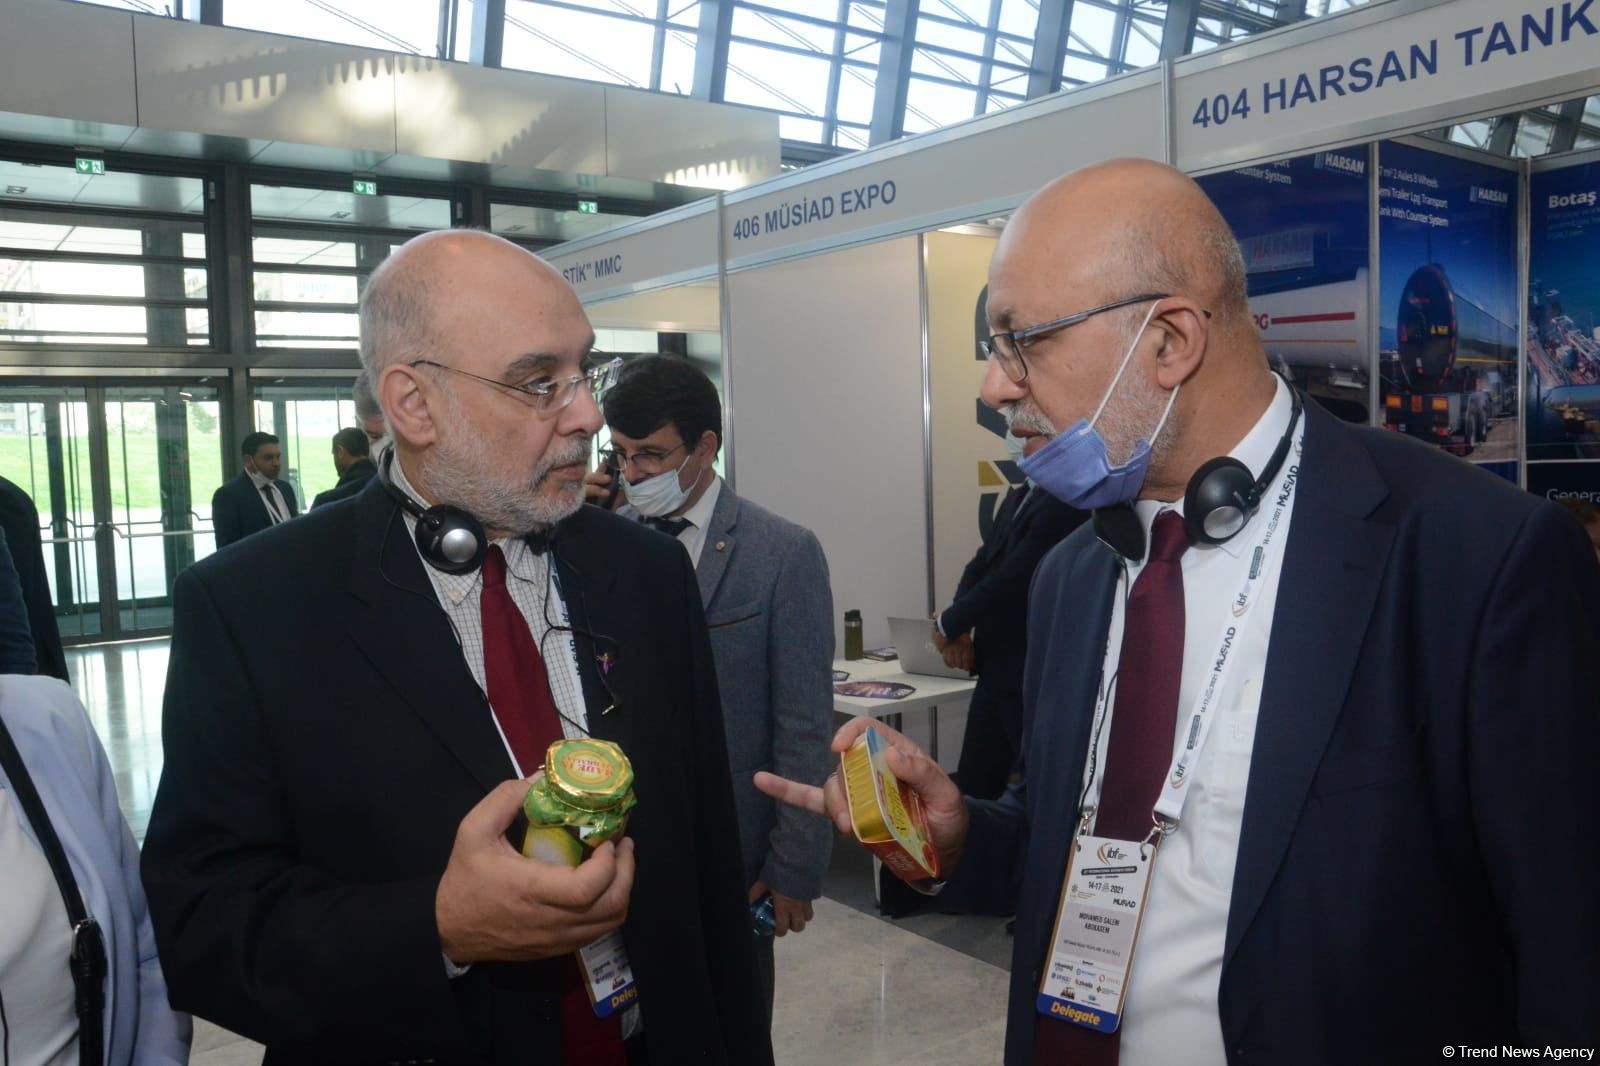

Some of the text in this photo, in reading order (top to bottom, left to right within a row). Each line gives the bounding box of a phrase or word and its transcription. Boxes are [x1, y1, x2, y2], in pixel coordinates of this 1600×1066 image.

[1192, 0, 1600, 128] 404 HARSAN TANK
[1325, 152, 1365, 174] HARSAN
[1264, 168, 1292, 184] System
[1418, 174, 1438, 188] Wheels
[1421, 193, 1448, 209] Transport
[1478, 187, 1509, 203] HARSAN
[1548, 191, 1597, 209] Botaş
[733, 180, 897, 240] 406 MÜSİAD EXPO
[1405, 209, 1428, 223] Counter
[1429, 214, 1449, 228] System
[595, 254, 622, 279] MMC
[1175, 765, 1186, 778] ibf
[1110, 885, 1124, 894] 2021
[1050, 1001, 1101, 1025] Delegate
